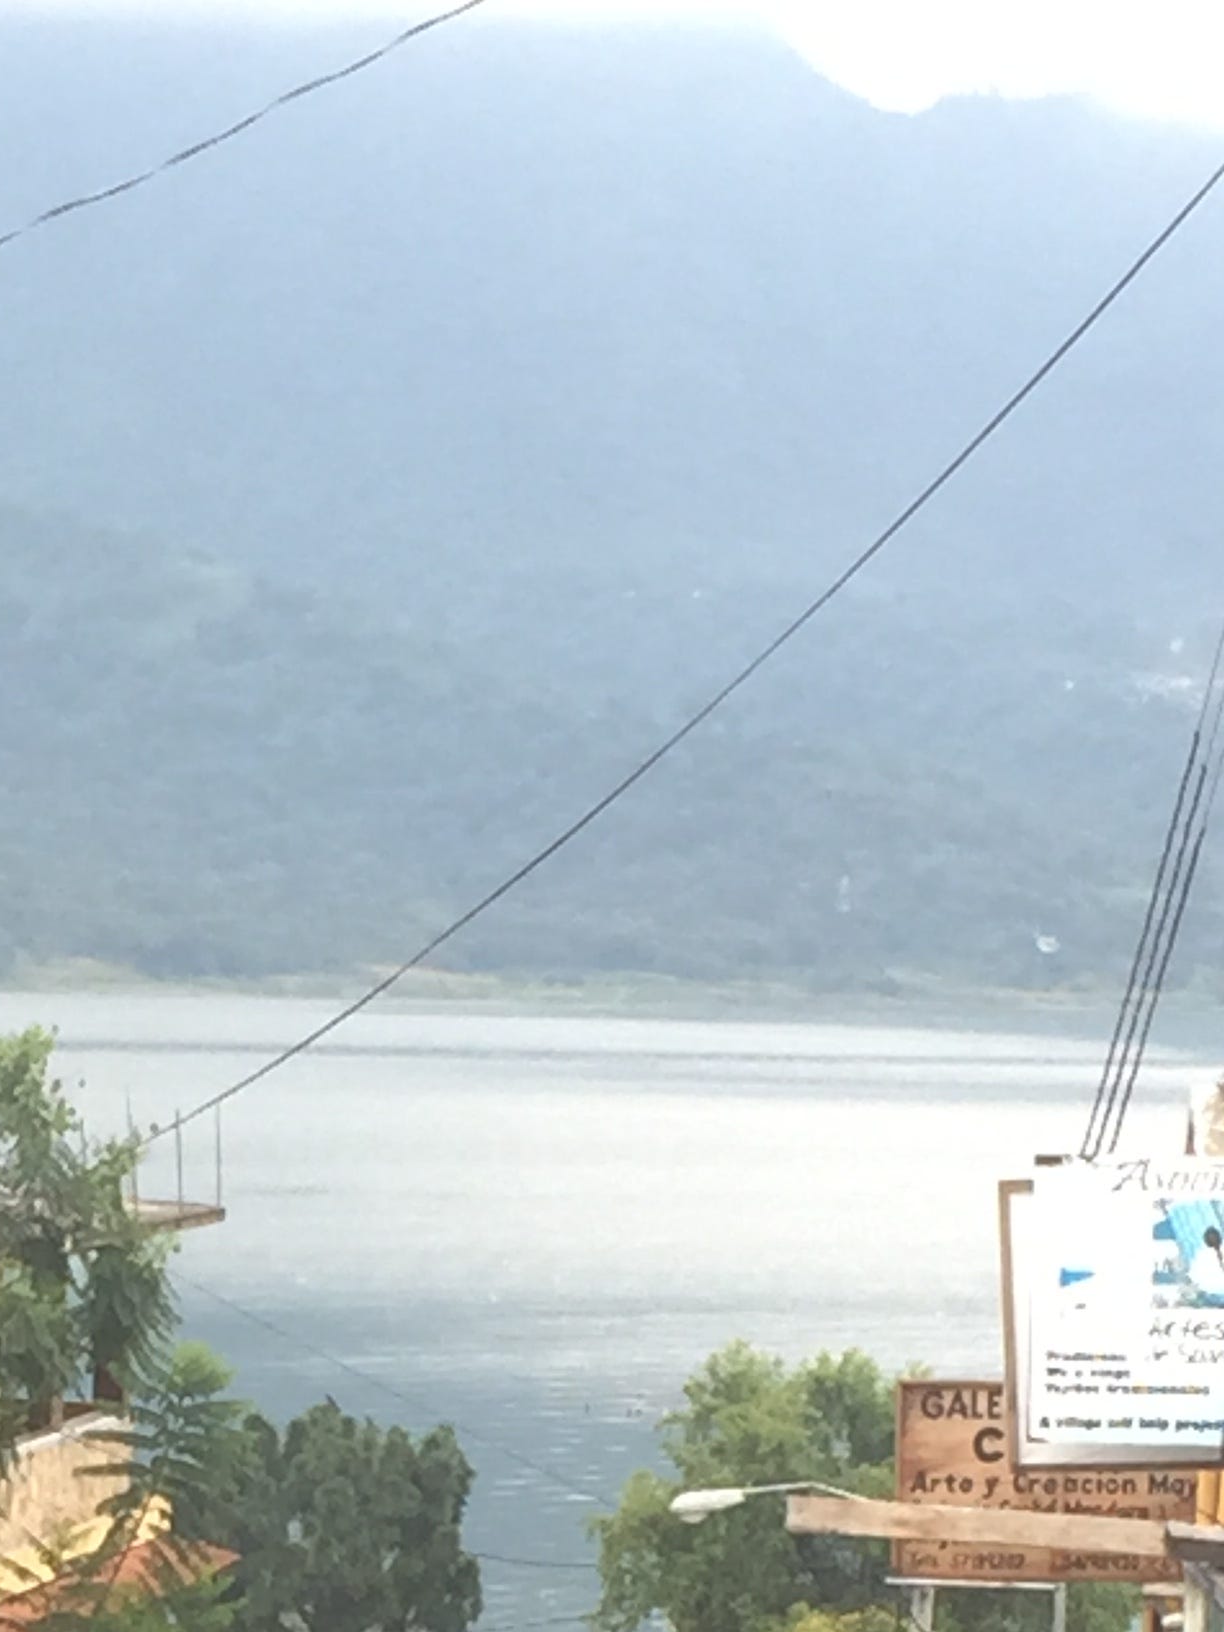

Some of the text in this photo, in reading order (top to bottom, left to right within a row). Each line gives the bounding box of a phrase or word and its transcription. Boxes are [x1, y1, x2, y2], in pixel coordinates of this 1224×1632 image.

[920, 1388, 1003, 1421] GALE
[910, 1469, 974, 1494] Arte
[982, 1475, 1000, 1500] y
[1147, 1473, 1196, 1500] May
